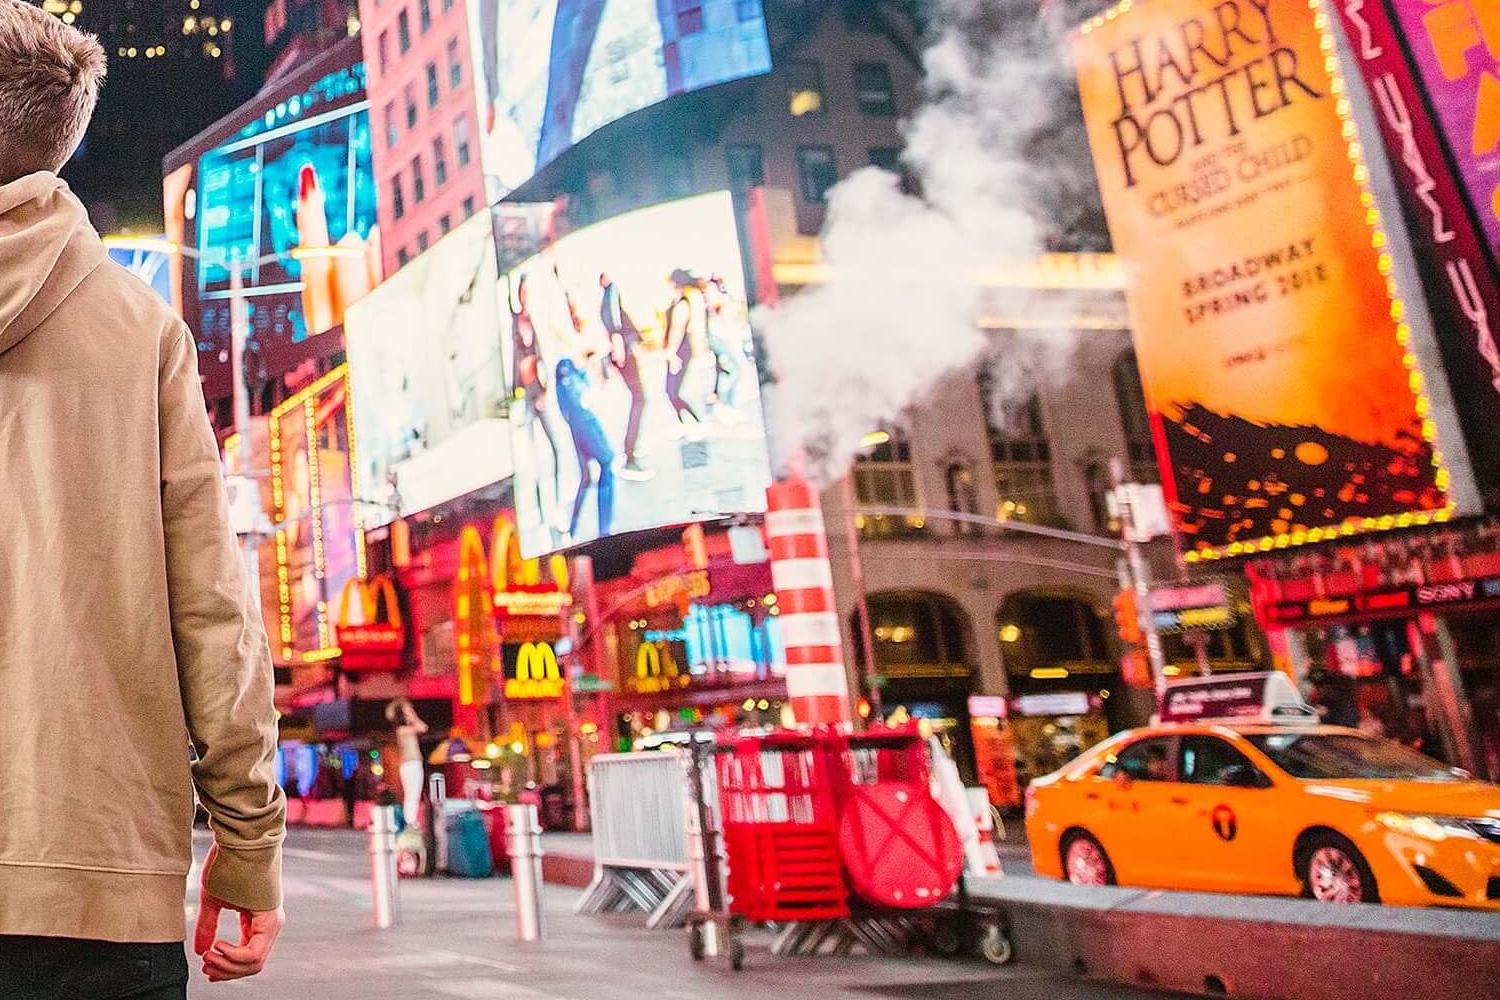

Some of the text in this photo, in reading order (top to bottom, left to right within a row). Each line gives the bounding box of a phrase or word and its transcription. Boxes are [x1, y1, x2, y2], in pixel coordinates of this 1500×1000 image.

[1113, 47, 1323, 187] POTTER
[1236, 134, 1314, 182] CHILD
[1183, 236, 1316, 297] BROADWAY
[1185, 280, 1269, 326] SPRING
[1418, 582, 1474, 603] SONY
